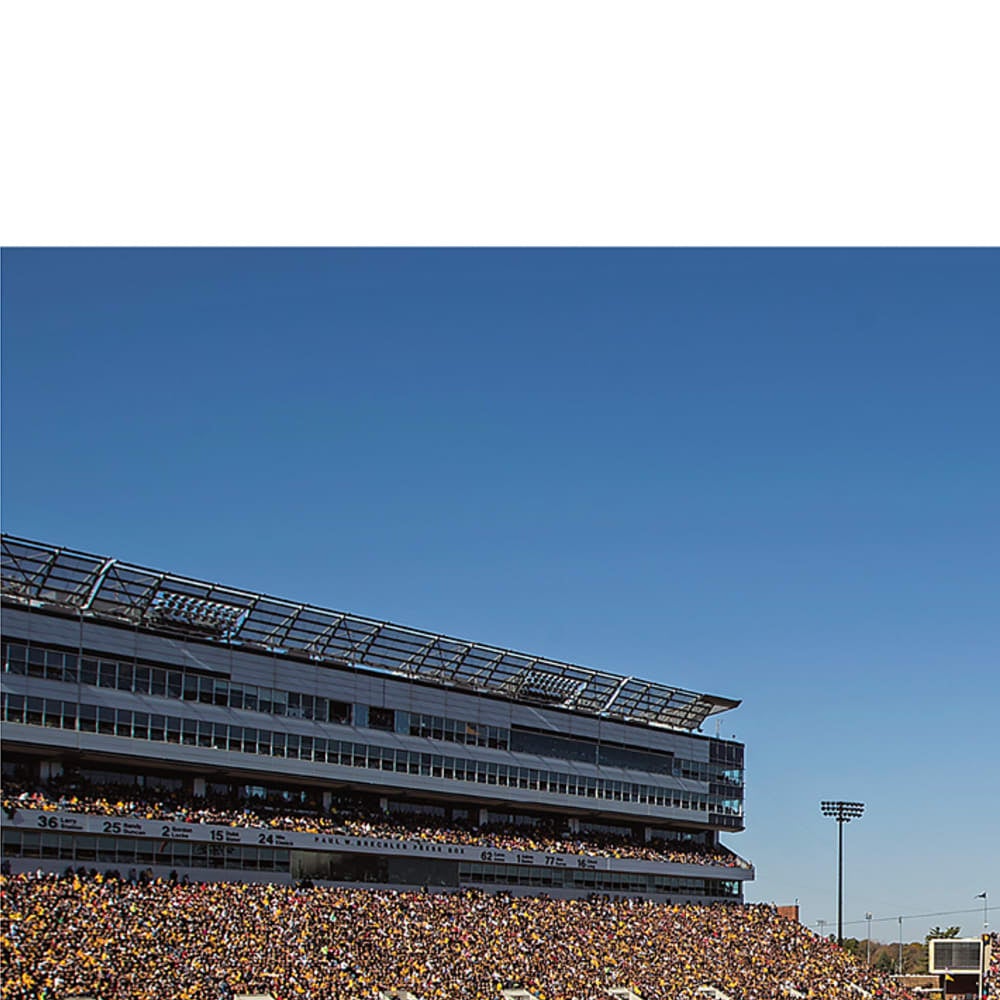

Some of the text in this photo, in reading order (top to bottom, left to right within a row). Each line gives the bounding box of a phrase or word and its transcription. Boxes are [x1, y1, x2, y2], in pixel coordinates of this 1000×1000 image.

[37, 815, 58, 828] 36
[103, 821, 121, 833] 25
[161, 825, 170, 837] 2
[210, 830, 224, 841] 15
[258, 833, 273, 844] 24
